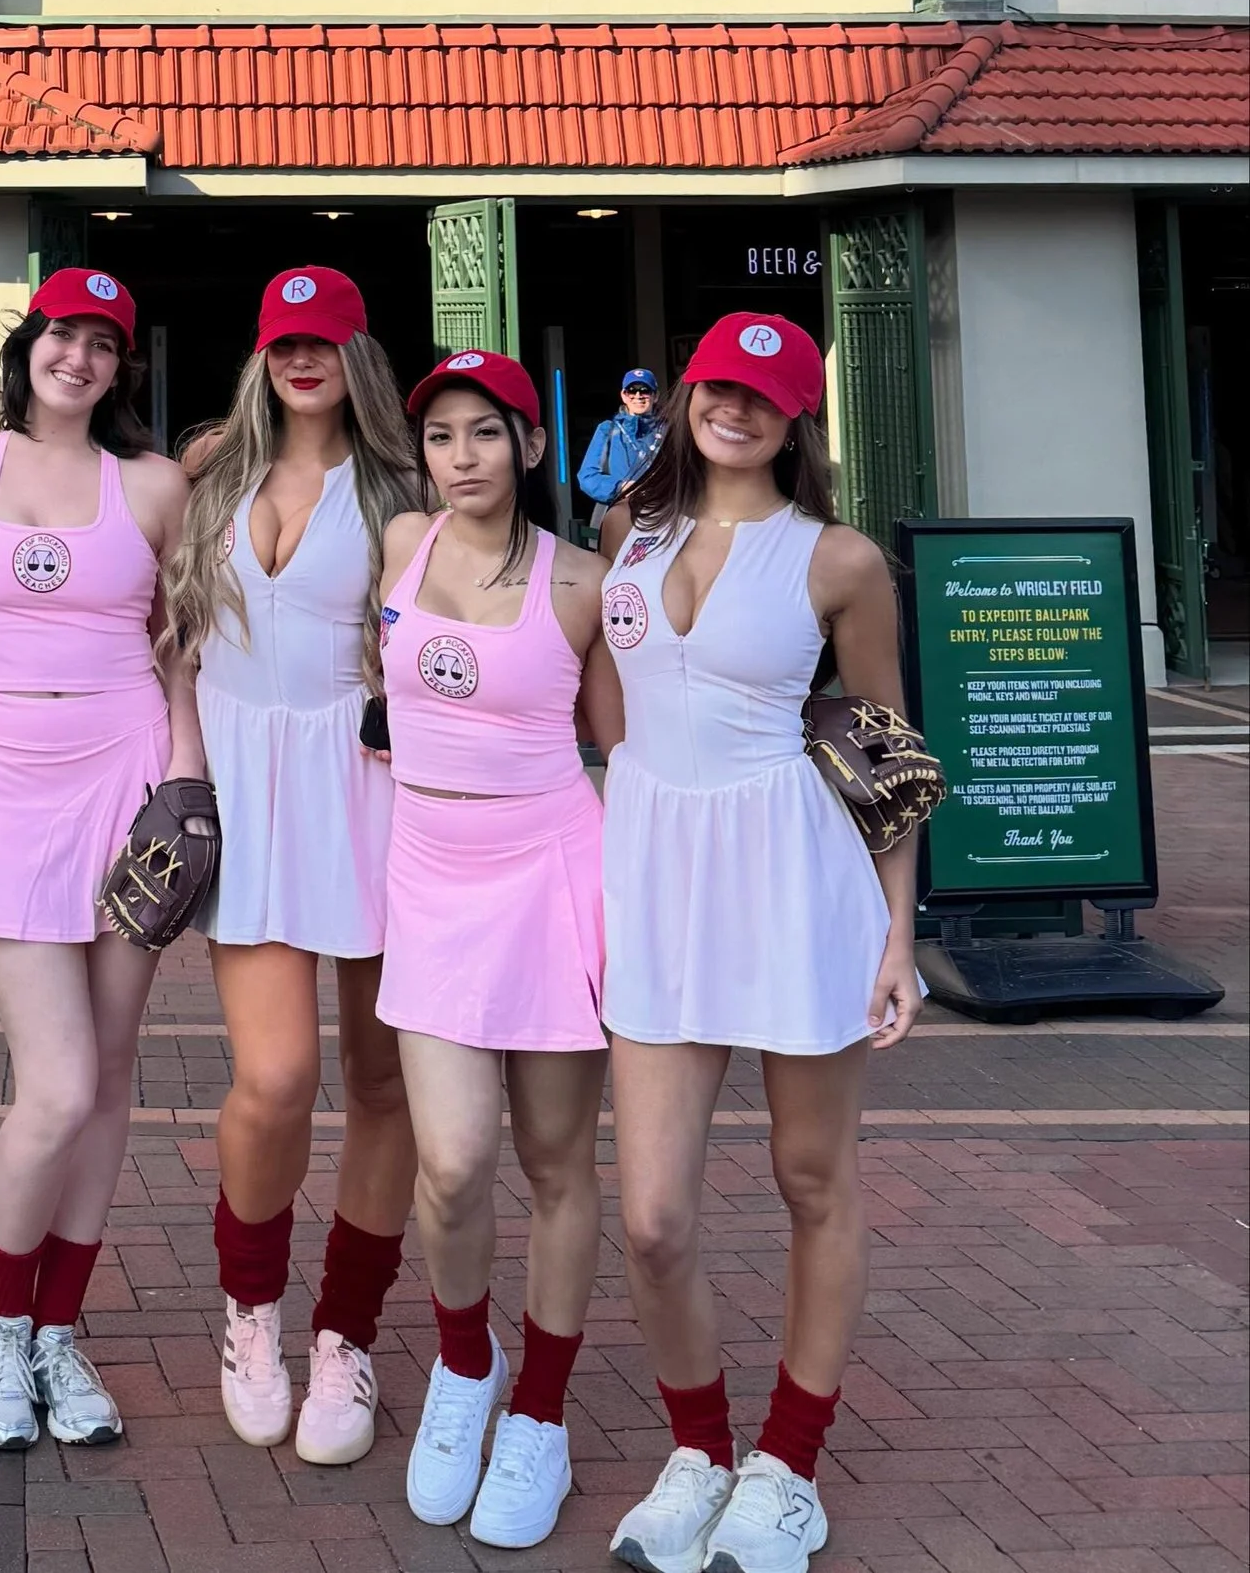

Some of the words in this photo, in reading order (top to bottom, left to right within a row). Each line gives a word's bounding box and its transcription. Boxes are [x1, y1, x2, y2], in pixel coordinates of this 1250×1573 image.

[748, 247, 797, 275] BEER
[96, 277, 111, 296] R
[291, 280, 306, 299] R
[749, 328, 772, 351] R
[16, 546, 25, 564] CITY
[25, 537, 35, 547] OF
[21, 573, 62, 590] PEACHES
[946, 581, 998, 596] Welcome
[1000, 583, 1012, 596] to
[1015, 581, 1067, 596] WRIGLEY
[1070, 580, 1102, 595] FIELD
[962, 610, 976, 622] TO
[980, 609, 1032, 622] EXPEDITE
[1036, 609, 1090, 621] BALLPARK
[950, 629, 989, 643] ENTRY,
[993, 629, 1033, 641] PLEASE
[1037, 628, 1079, 641] FOLLOW
[1082, 628, 1102, 640] THE
[421, 647, 432, 667] CITY
[432, 639, 443, 649] OF
[445, 638, 476, 678] ROCKFORD
[990, 649, 1024, 661] STEPS
[1028, 648, 1068, 660] BELOW:
[427, 677, 471, 696] PEACHES
[968, 681, 985, 690] KEEP
[987, 681, 1006, 690] YOUR
[1008, 681, 1029, 690] ITEMS
[1031, 680, 1049, 690] WITH
[1050, 680, 1064, 689] YOU
[1066, 679, 1102, 689] INCLUDING
[996, 692, 1013, 701] KEYS
[1015, 692, 1030, 701] AND
[1031, 691, 1058, 700] WALLET
[969, 714, 988, 723] SCAN
[990, 714, 1009, 723] YOUR
[1011, 713, 1037, 722] MOBILE
[1038, 713, 1062, 722] TICKET
[1064, 713, 1072, 721] AT
[1074, 712, 1088, 721] ONE
[1089, 712, 1097, 720] OF
[1098, 712, 1112, 720] OUR
[1027, 724, 1051, 733] TICKET
[1053, 723, 1090, 732] PEDESTALS
[971, 747, 997, 756] PLEASE
[999, 746, 1031, 756] PROCEED
[1032, 746, 1065, 755] DIRECTLY
[1066, 745, 1099, 754] THROUGH
[971, 758, 985, 767] THE
[987, 757, 1010, 767] METAL
[1011, 757, 1048, 766] DETECTOR
[1049, 757, 1063, 766] FOR
[1064, 756, 1086, 765] ENTRY
[953, 785, 965, 794] ALL
[967, 785, 994, 793] GUESTS
[996, 784, 1011, 793] AND
[1012, 784, 1033, 793] THEIR
[1035, 783, 1071, 793] PROPERTY
[1072, 782, 1085, 791] ARE
[1086, 781, 1116, 791] SUBJECT
[962, 796, 972, 805] TO
[1017, 795, 1027, 804] NO
[1029, 794, 1070, 804] PROHIBITED
[1072, 793, 1093, 803] ITEMS
[1094, 793, 1109, 802] MAY
[999, 806, 1022, 815] ENTER
[1023, 806, 1037, 815] THE
[1004, 829, 1043, 846] Thank
[1050, 829, 1074, 850] You
